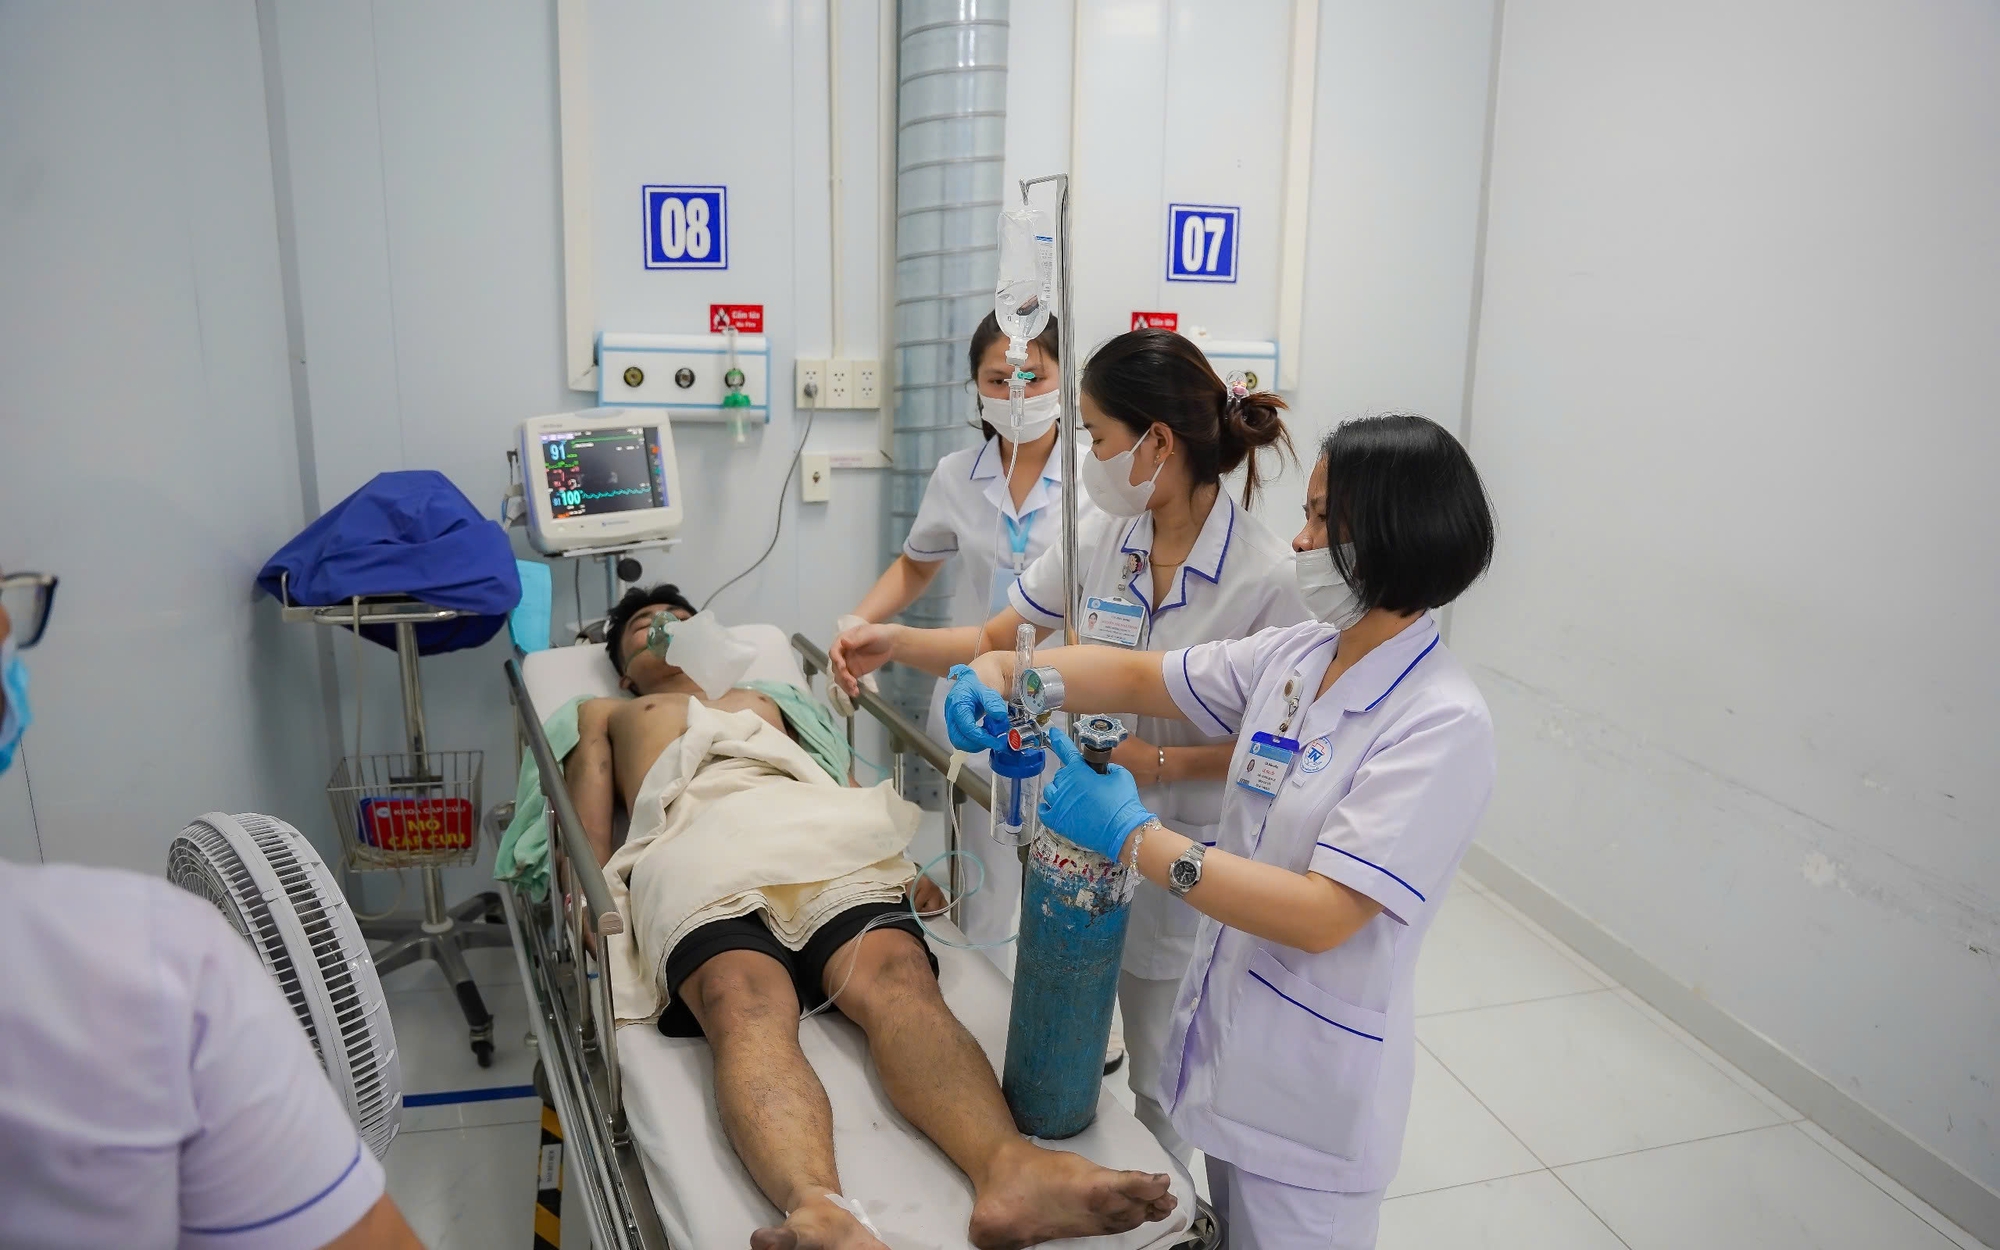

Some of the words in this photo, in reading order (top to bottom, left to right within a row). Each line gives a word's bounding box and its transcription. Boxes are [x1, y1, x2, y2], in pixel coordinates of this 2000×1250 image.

[660, 197, 711, 259] 08
[1181, 215, 1227, 272] 07
[550, 443, 566, 460] 91
[561, 490, 581, 506] 100
